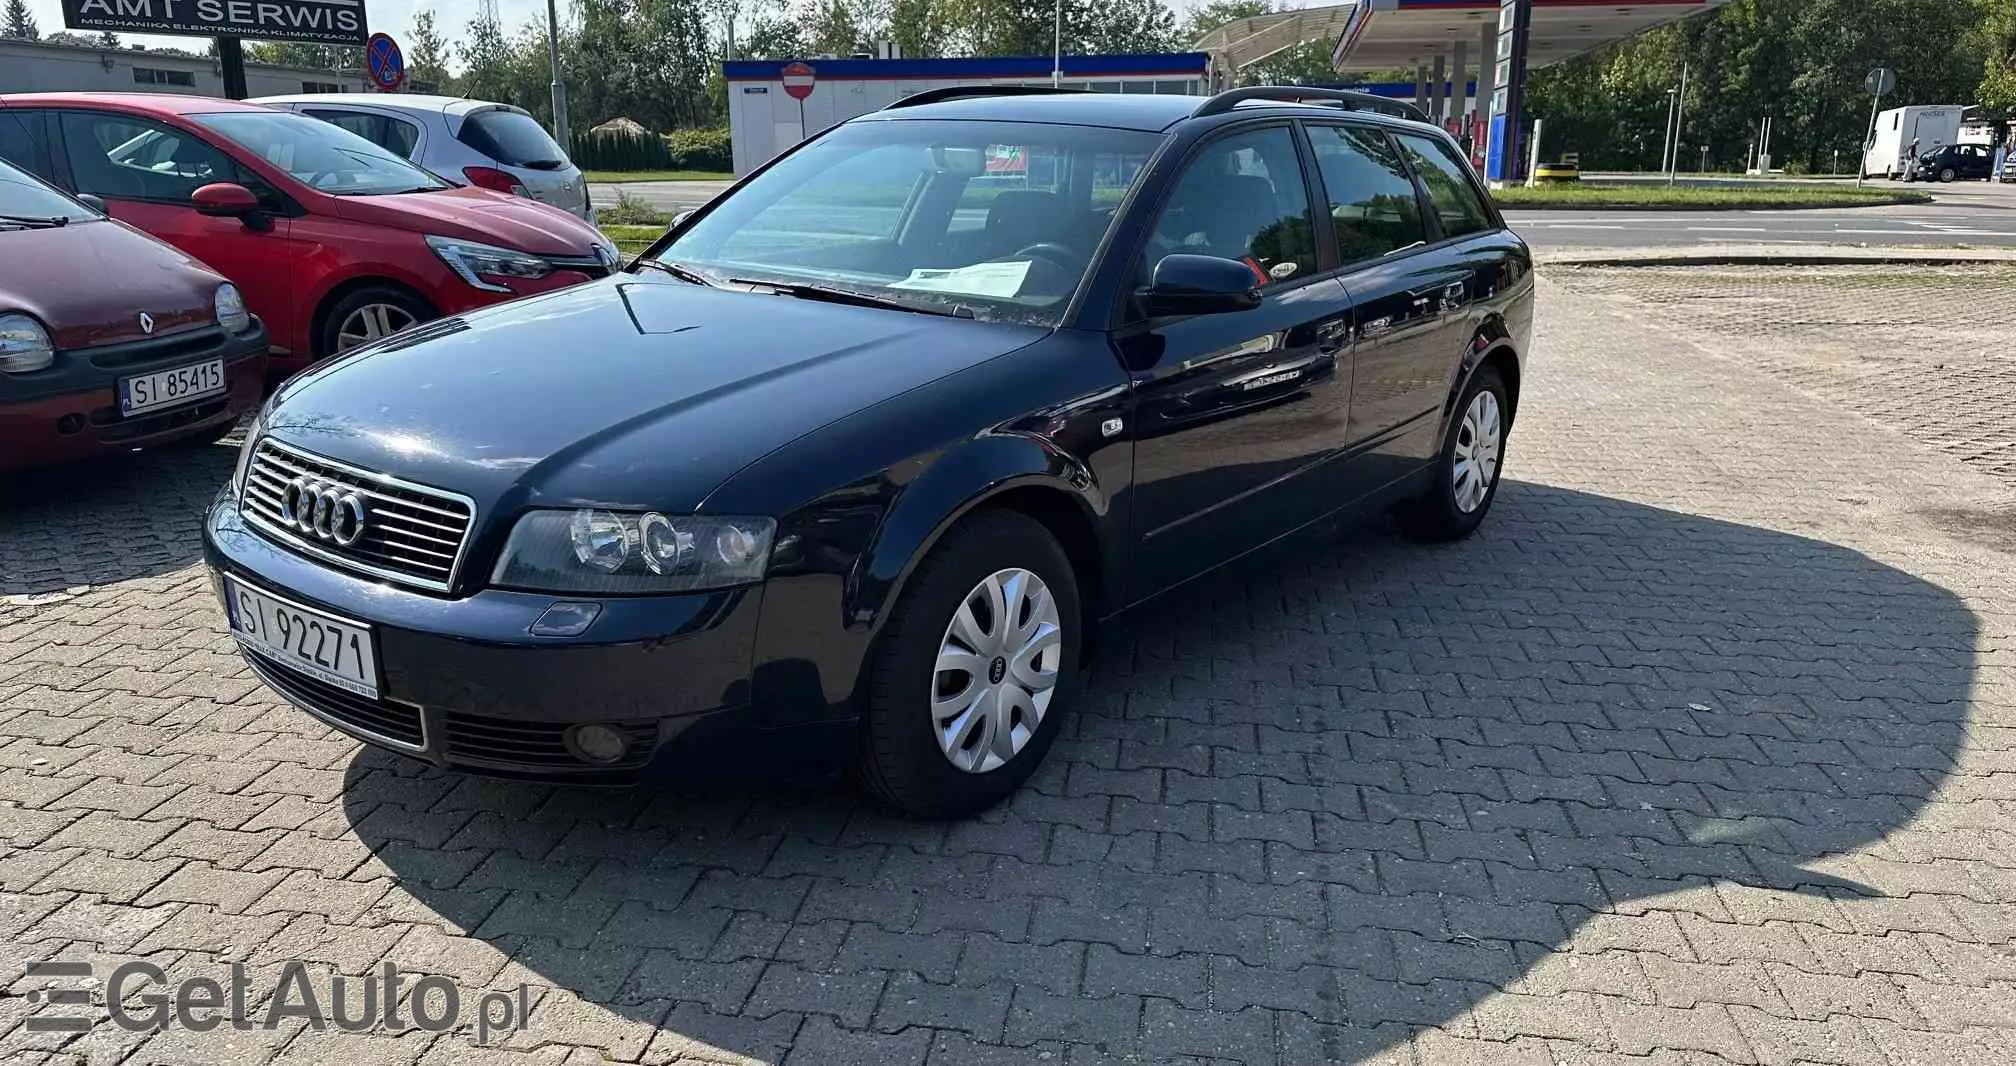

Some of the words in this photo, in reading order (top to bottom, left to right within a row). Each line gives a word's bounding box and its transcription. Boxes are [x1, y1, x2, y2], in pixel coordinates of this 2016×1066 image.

[80, 0, 181, 18] AMT
[197, 0, 359, 31] SERWIS
[81, 19, 170, 29] MECHANIKA
[173, 23, 269, 35] ELEKTRONIKA
[271, 30, 360, 41] KLIMATYZACJA
[135, 377, 157, 404] SI
[167, 363, 220, 397] 85415
[240, 591, 268, 641] SI
[277, 608, 364, 680] 92271
